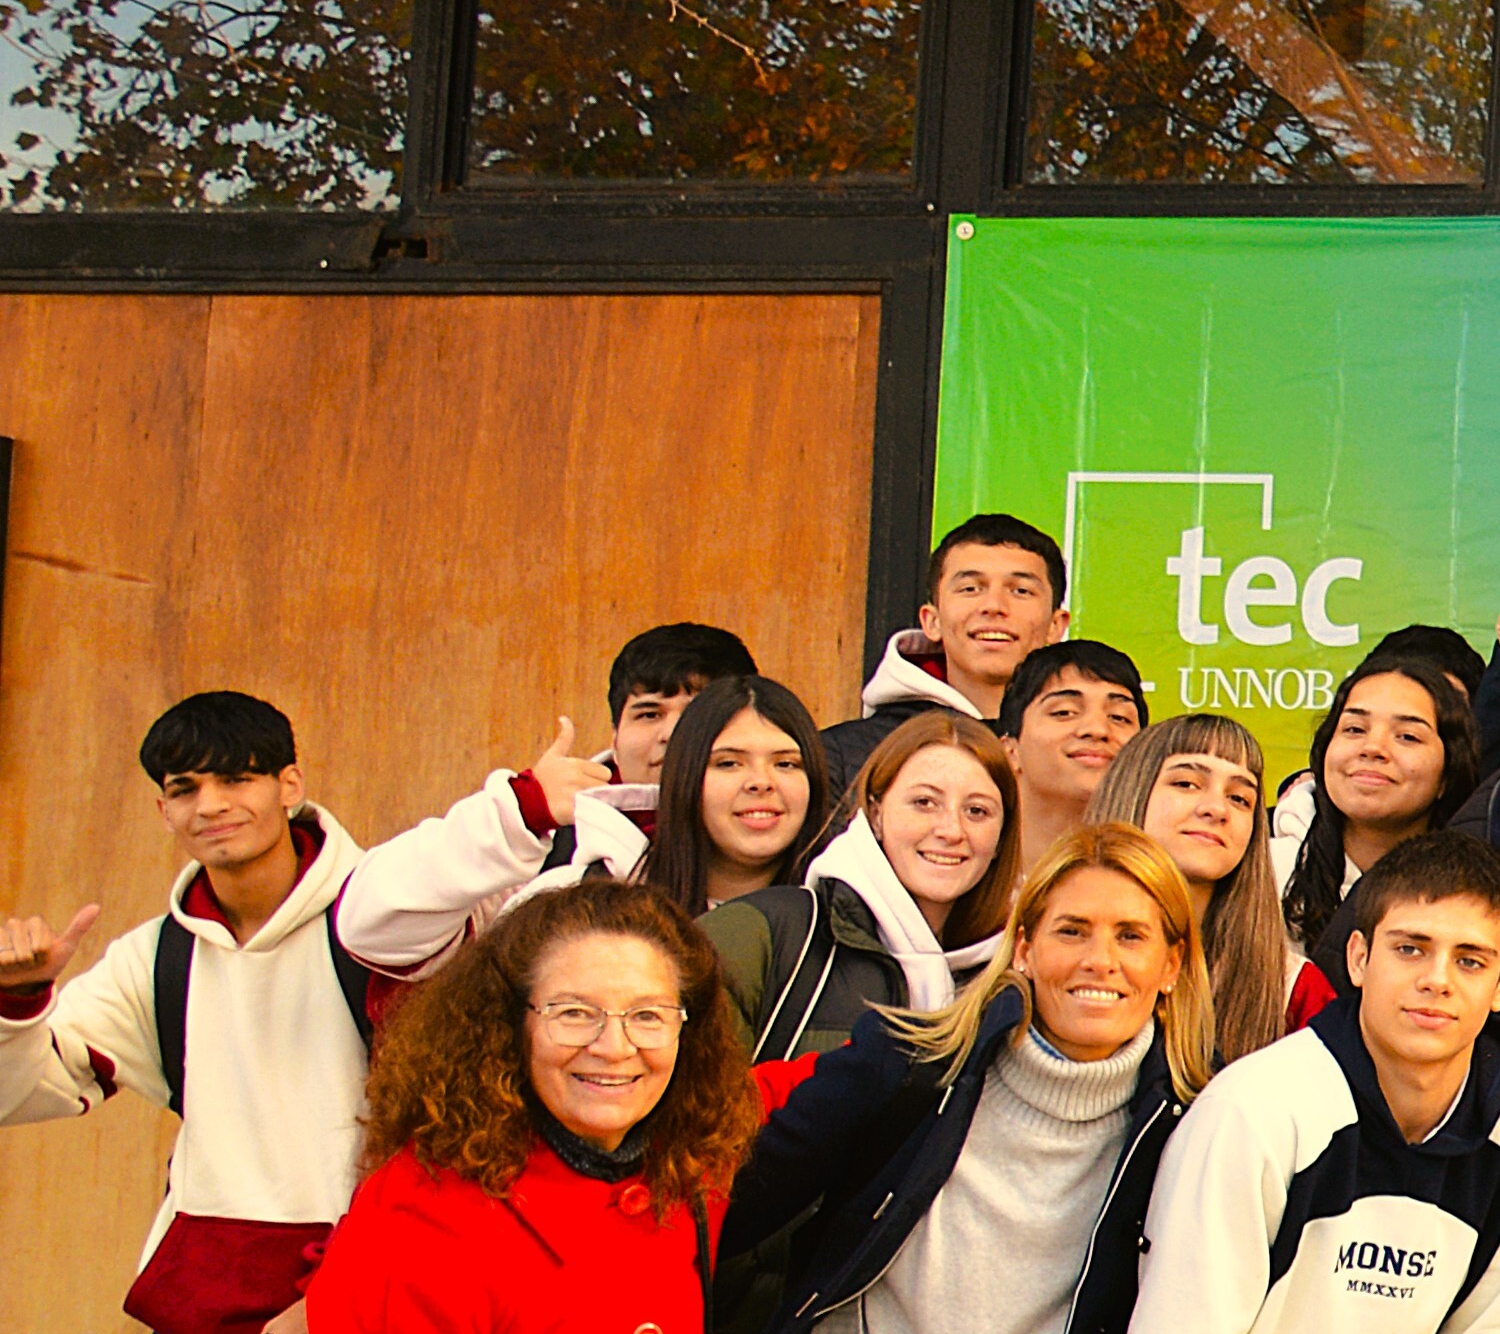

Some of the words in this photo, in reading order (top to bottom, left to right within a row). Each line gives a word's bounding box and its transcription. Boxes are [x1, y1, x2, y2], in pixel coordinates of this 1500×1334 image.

[1166, 527, 1363, 646] tec
[1178, 667, 1352, 710] UNNOB
[1334, 1241, 1437, 1277] MONSE
[1346, 1279, 1416, 1299] MMXXVI
